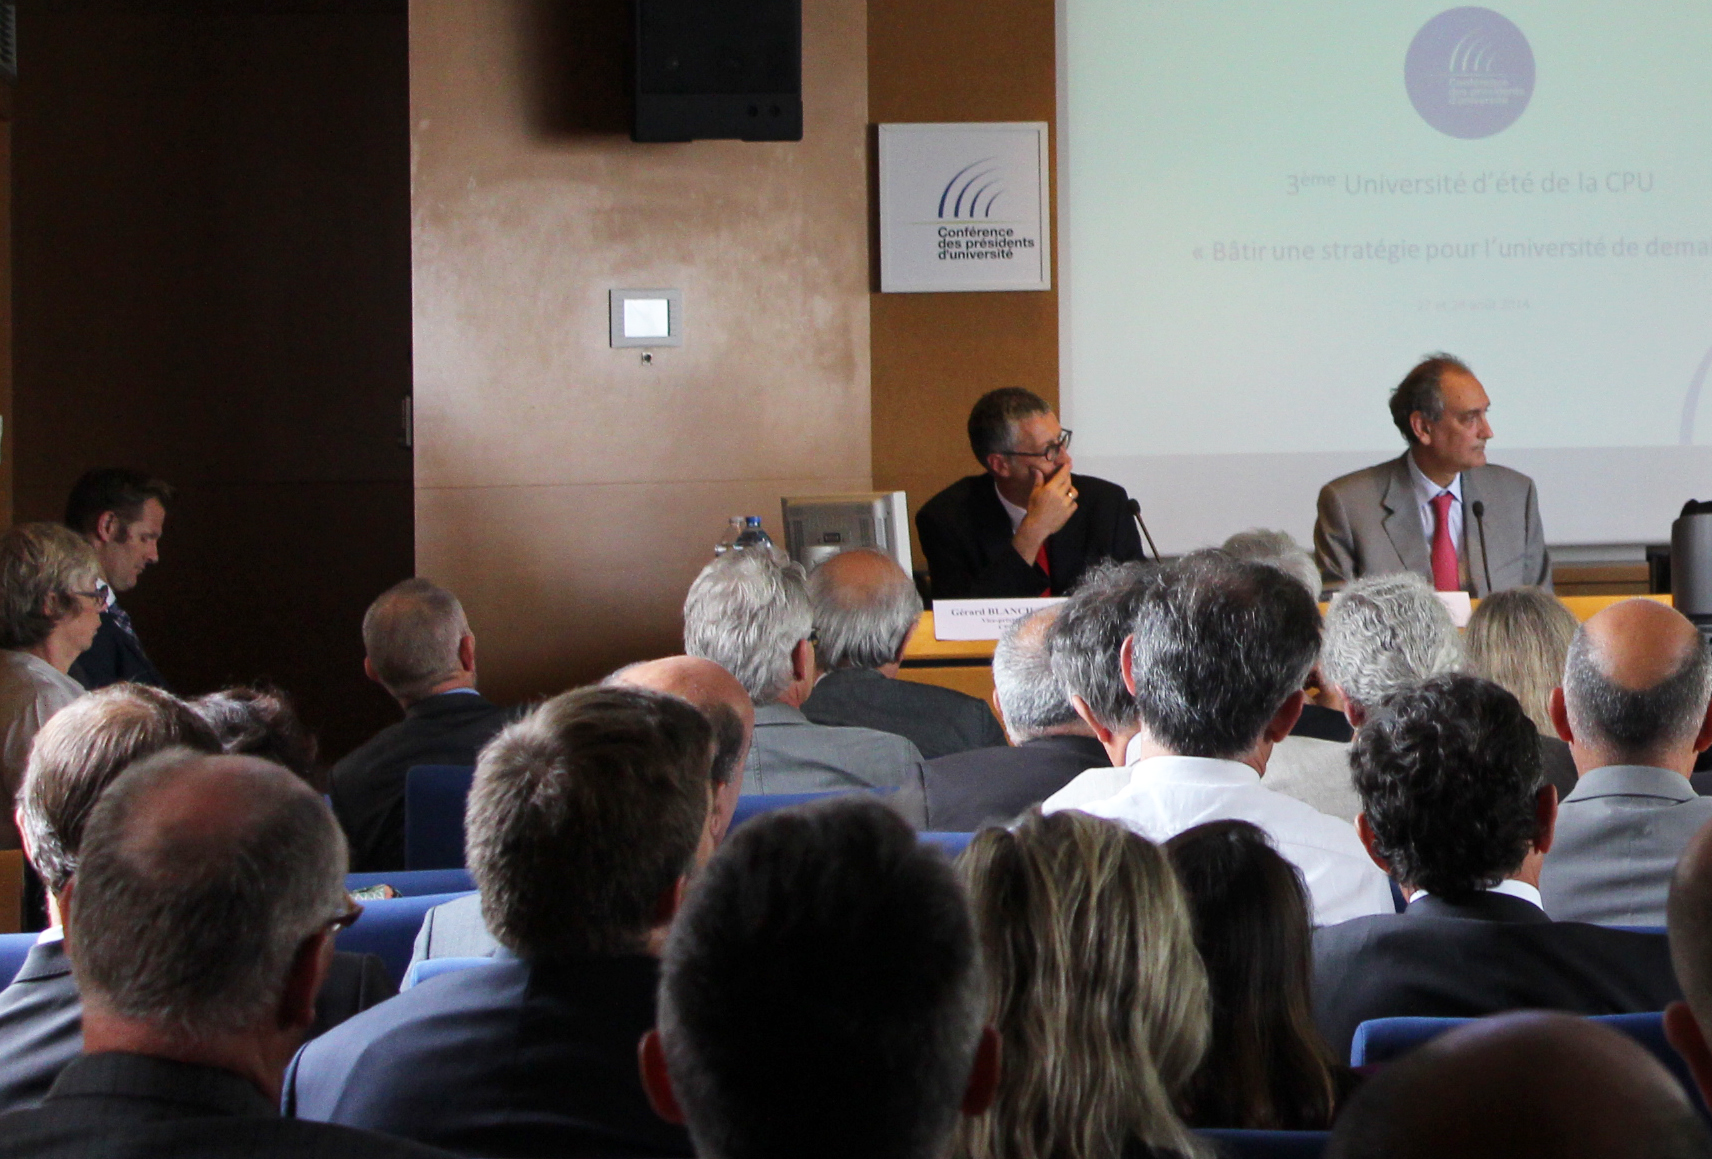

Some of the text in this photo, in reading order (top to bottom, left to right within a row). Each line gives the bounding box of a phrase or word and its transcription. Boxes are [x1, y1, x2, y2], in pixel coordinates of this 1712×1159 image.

[1285, 171, 1336, 196] 3ème
[1344, 170, 1467, 195] Université
[1541, 169, 1570, 194] de
[1578, 169, 1598, 194] la
[1605, 171, 1655, 194] CPU
[938, 226, 1014, 238] Conférence
[938, 237, 1035, 251] des présidents
[1212, 239, 1269, 262] Bâtir
[1272, 245, 1316, 262] une
[1321, 238, 1420, 265] stratégie
[1425, 242, 1478, 264] pour
[1612, 236, 1639, 258] de
[938, 249, 1014, 260] d'université
[951, 607, 1034, 616] Gérard BLANCH
